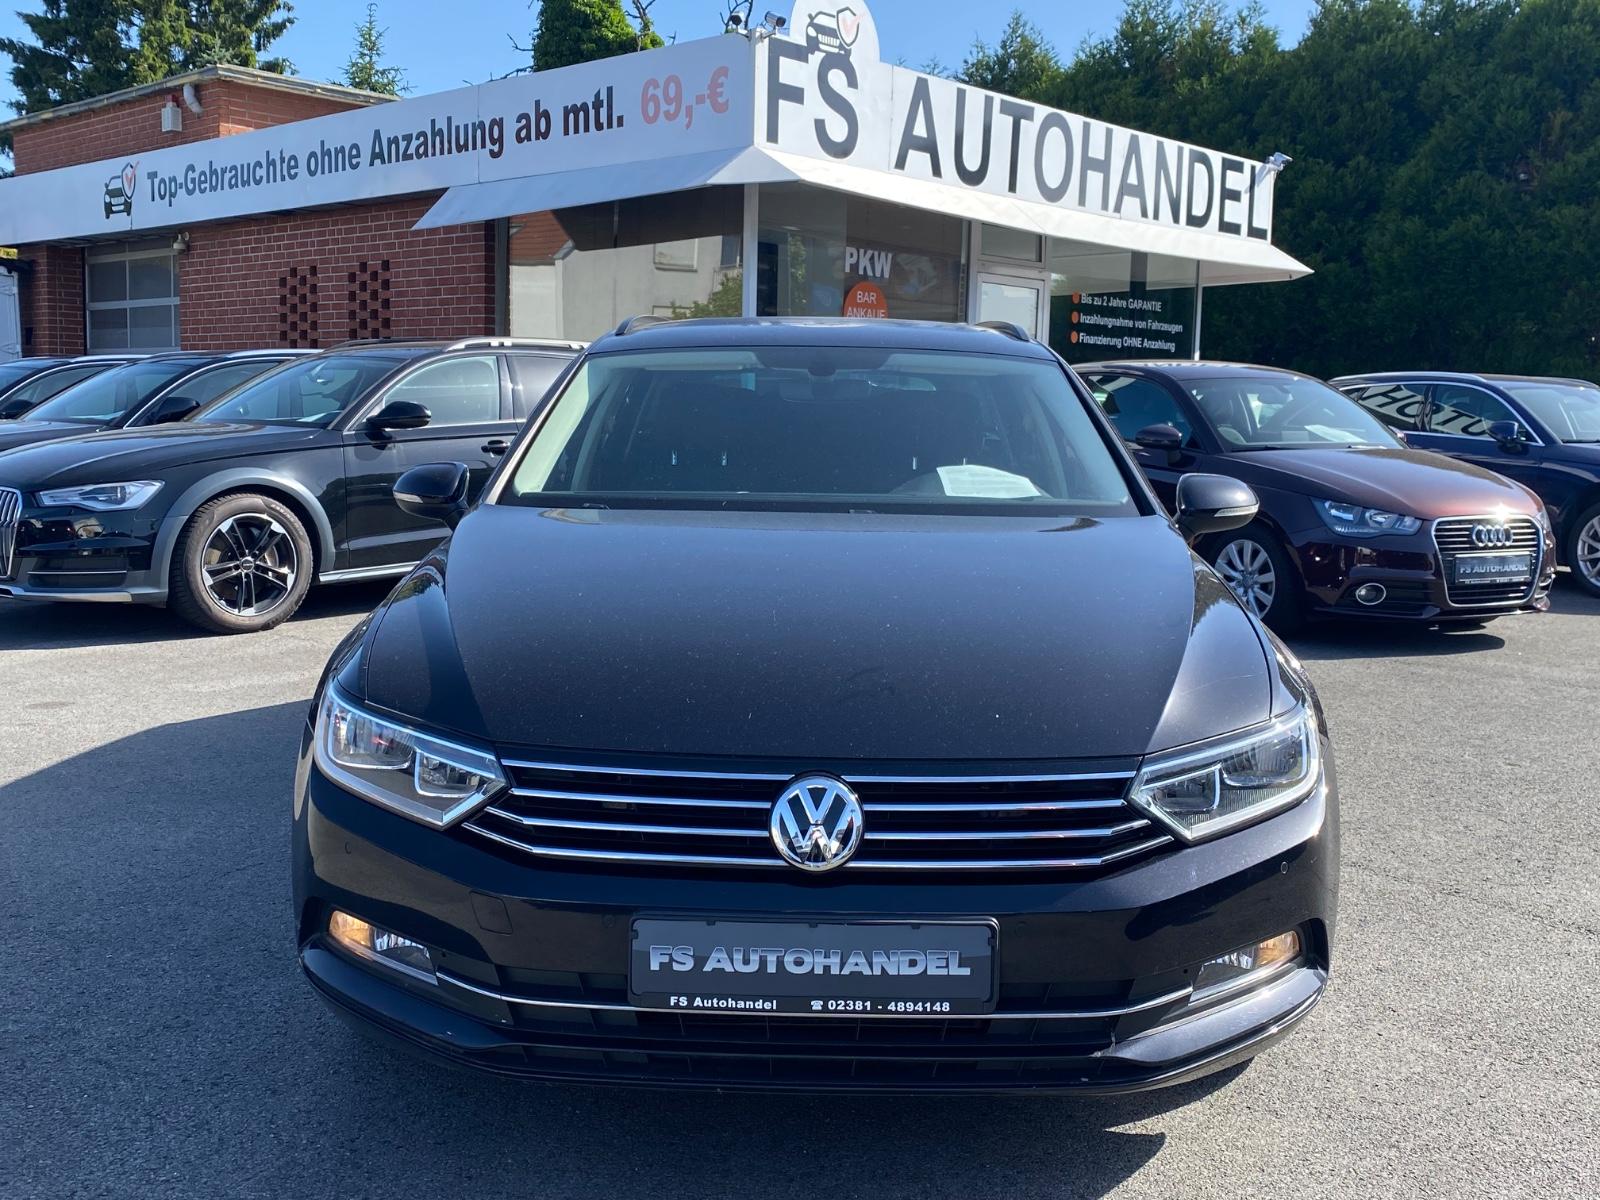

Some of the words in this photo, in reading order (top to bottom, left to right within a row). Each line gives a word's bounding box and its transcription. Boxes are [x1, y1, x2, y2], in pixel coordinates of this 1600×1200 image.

[147, 150, 299, 207] Top-Gebrauchte
[306, 139, 361, 177] ohne
[369, 116, 504, 167] Anzahlung
[515, 100, 552, 144] ab
[563, 86, 624, 136] mtl.
[640, 66, 729, 130] 69,-€
[767, 37, 858, 159] FS
[894, 77, 1269, 240] AUTOHANDEL
[845, 246, 893, 279] PKW
[857, 291, 877, 305] BAR
[1081, 293, 1092, 304] Bis
[1093, 297, 1102, 305] zu
[1103, 296, 1108, 306] 2
[1109, 297, 1127, 308] Jahre
[1128, 298, 1162, 312] GARANTIE
[1080, 313, 1133, 328] Inzahlungnahme
[1135, 320, 1147, 329] von
[1147, 319, 1183, 334] Fahrzeugen
[1080, 332, 1122, 348] Finanzierung
[1123, 336, 1142, 348] OHNE
[1143, 338, 1176, 352] Anzahlung
[650, 945, 695, 972] FS
[702, 946, 971, 976] AUTOHANDEL
[670, 996, 688, 1007] FS
[693, 996, 777, 1010] Autohandel
[828, 1000, 872, 1011] 02381
[887, 1001, 951, 1012] 4894148
